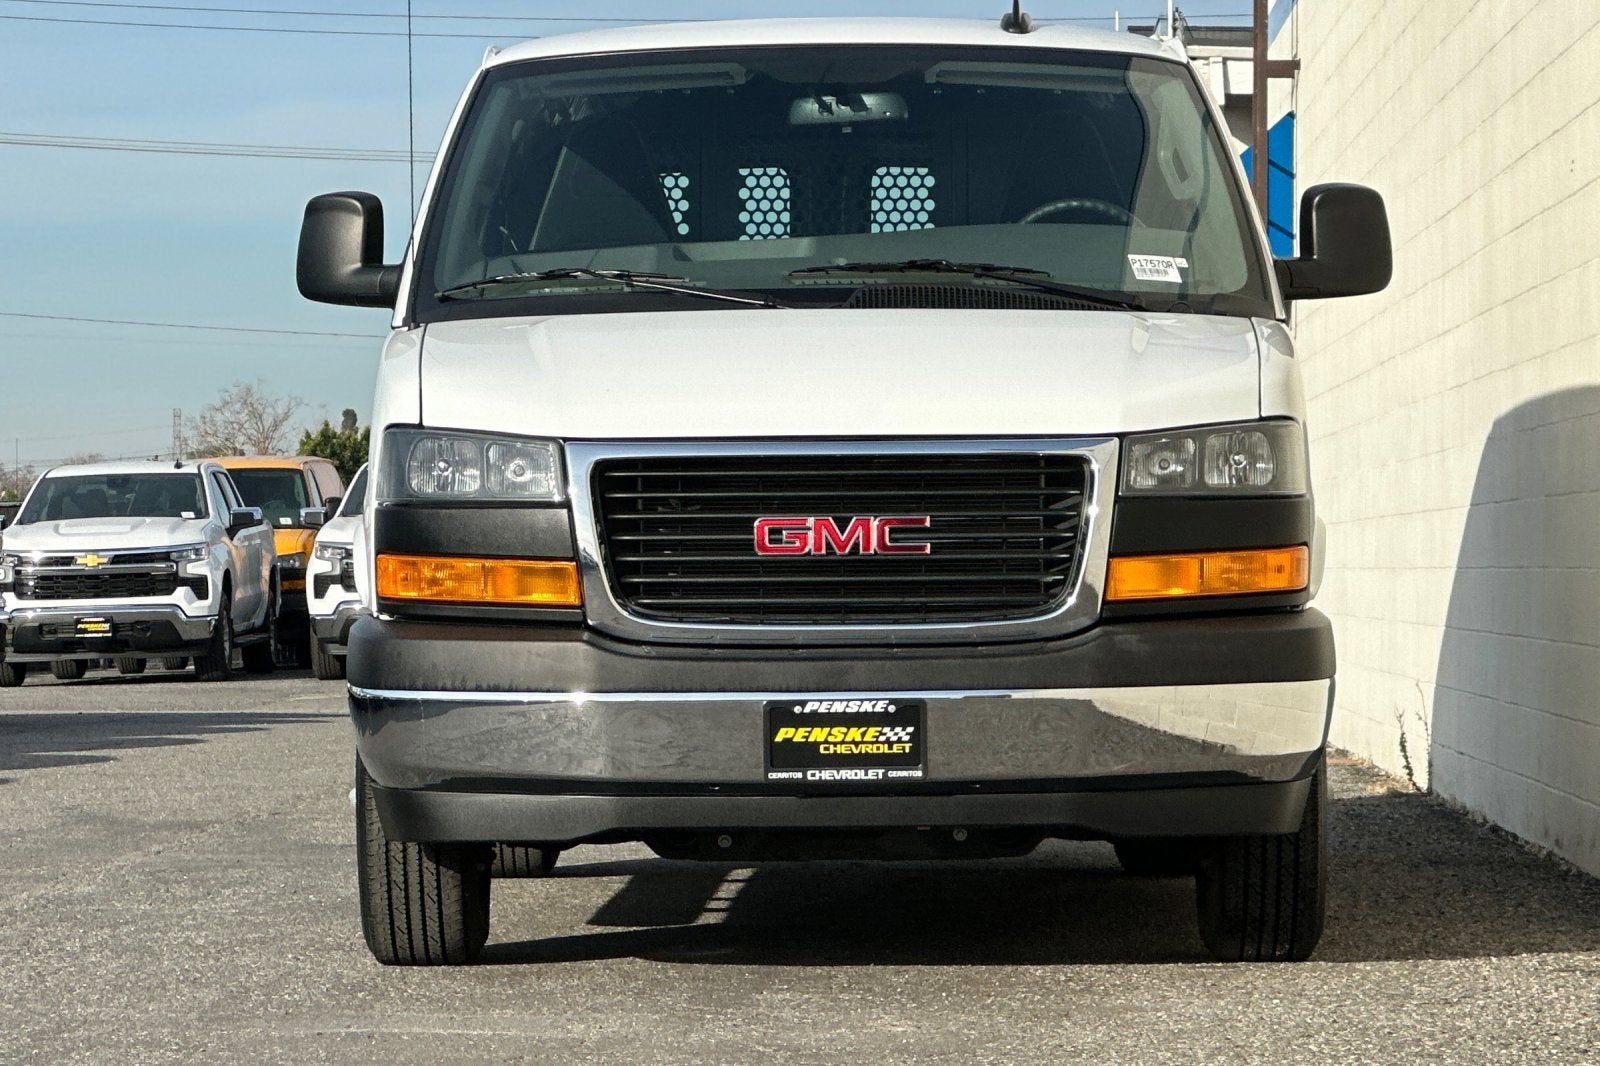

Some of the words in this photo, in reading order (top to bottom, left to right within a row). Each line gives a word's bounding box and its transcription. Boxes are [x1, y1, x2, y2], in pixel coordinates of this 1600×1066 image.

[754, 516, 930, 555] GMC
[803, 700, 889, 713] PENSKE
[774, 727, 882, 742] PENSKE
[819, 743, 912, 754] CHEVROLET
[807, 769, 885, 780] CHEVROLET
